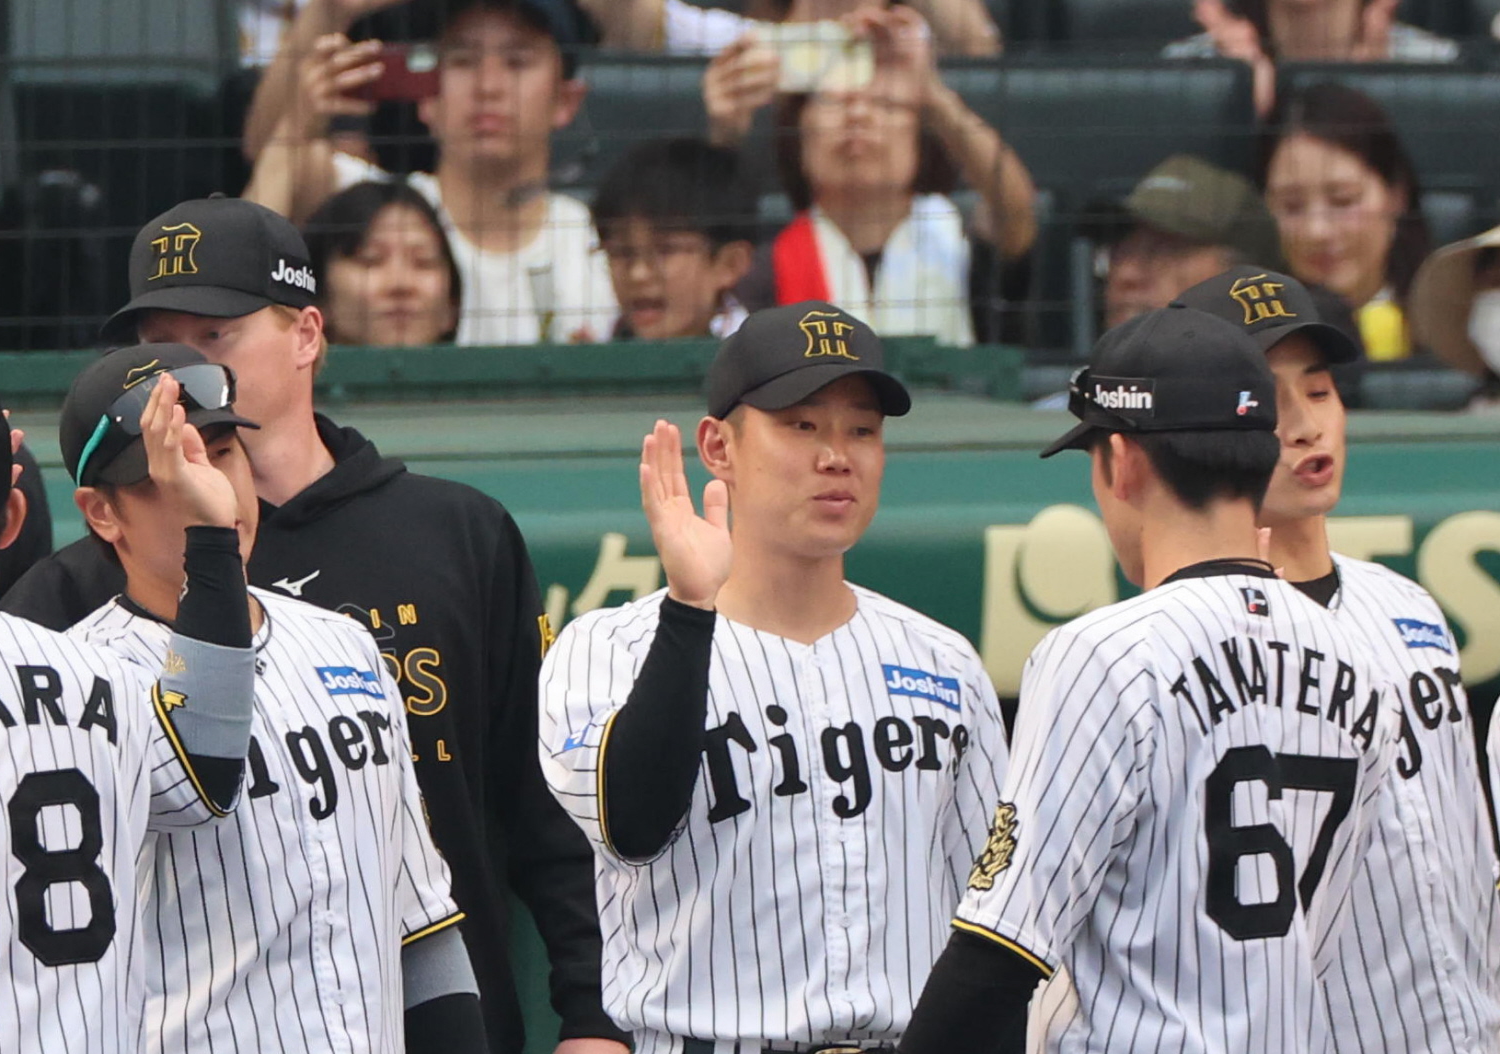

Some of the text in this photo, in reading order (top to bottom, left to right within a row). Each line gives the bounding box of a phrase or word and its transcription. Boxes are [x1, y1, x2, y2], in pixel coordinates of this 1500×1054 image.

[271, 258, 317, 295] Joshin
[1094, 384, 1153, 410] Joshin
[886, 669, 959, 705] Joshin
[1170, 637, 1379, 754] TAKATERA
[1205, 743, 1359, 941] 67
